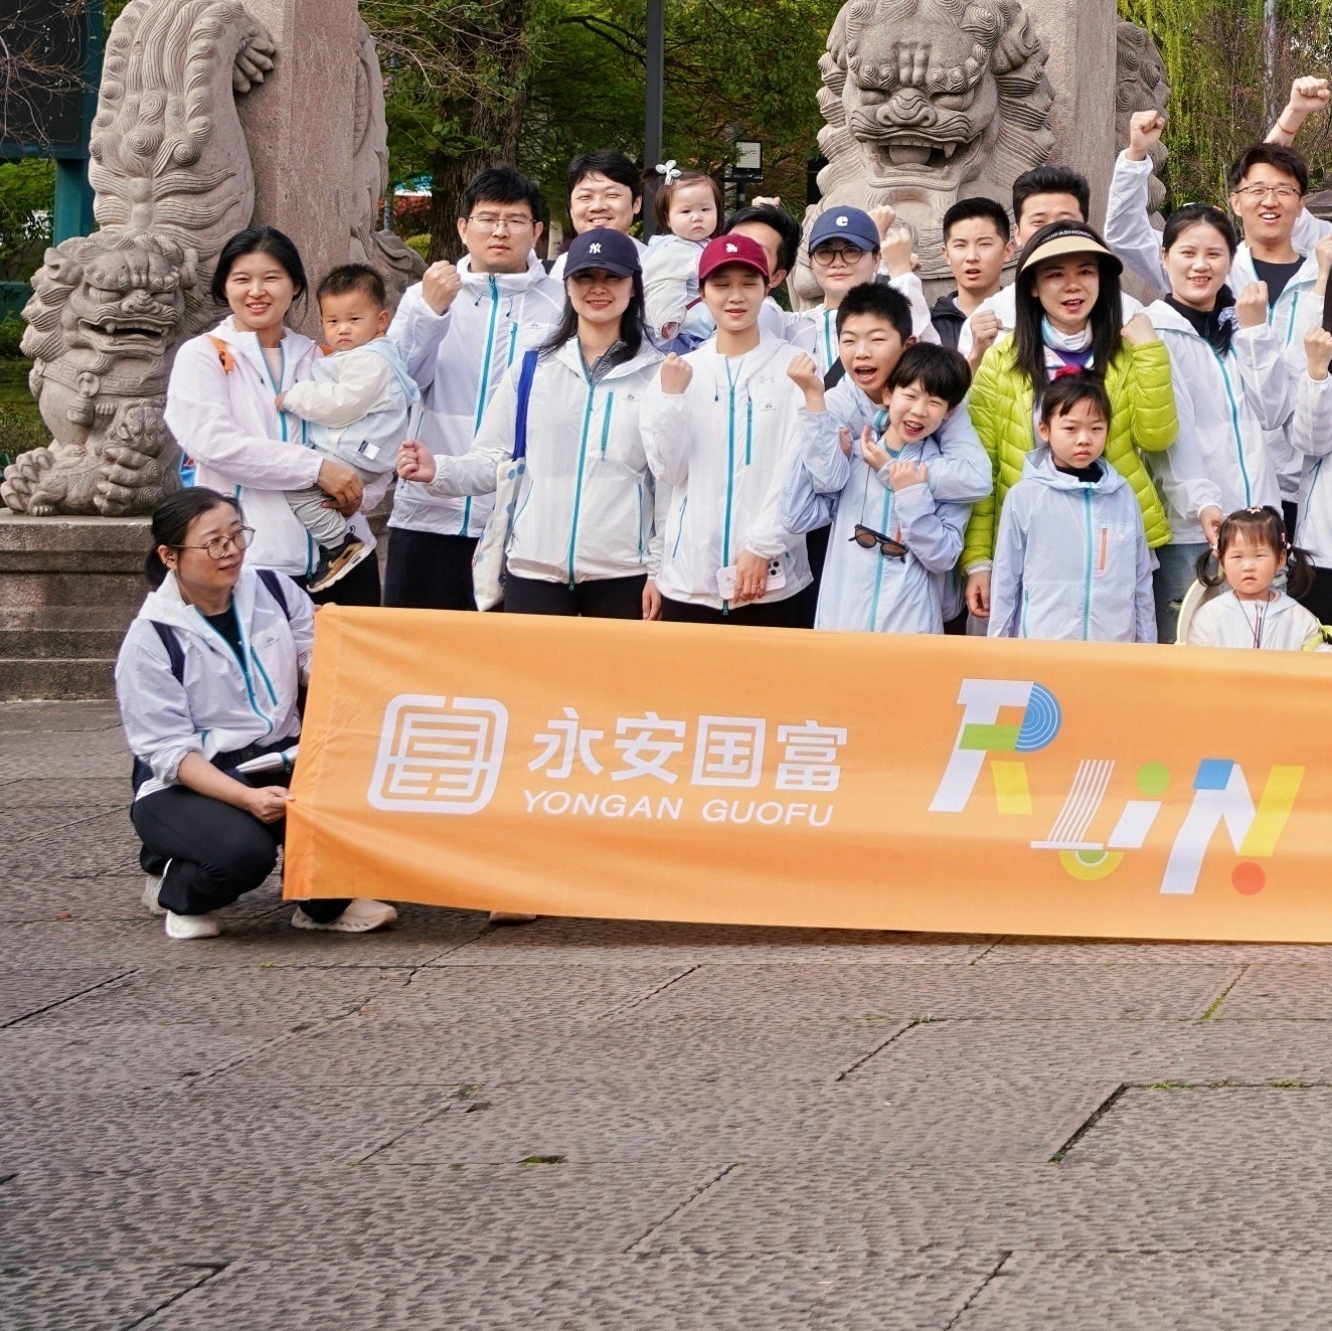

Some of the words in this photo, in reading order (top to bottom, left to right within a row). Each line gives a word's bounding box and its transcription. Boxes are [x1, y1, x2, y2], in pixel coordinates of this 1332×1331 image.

[589, 242, 602, 254] NY
[528, 706, 849, 792] 永安国富
[523, 789, 684, 820] YONGAN
[702, 799, 835, 827] GUOFU
